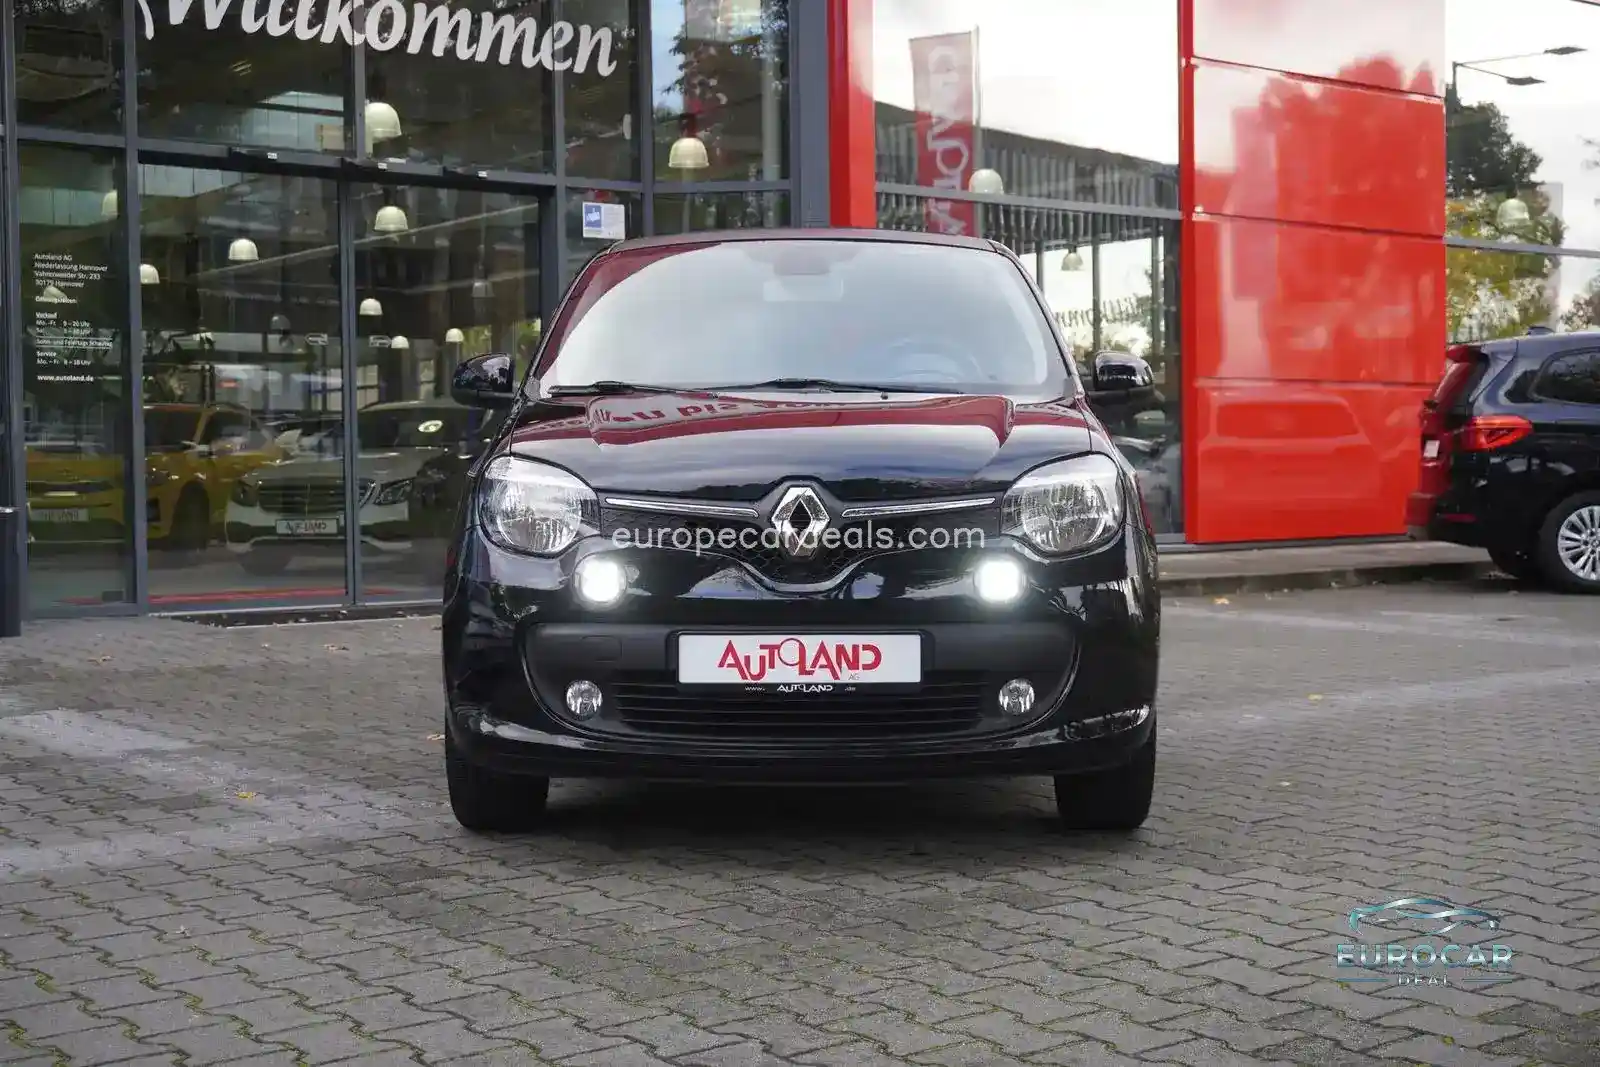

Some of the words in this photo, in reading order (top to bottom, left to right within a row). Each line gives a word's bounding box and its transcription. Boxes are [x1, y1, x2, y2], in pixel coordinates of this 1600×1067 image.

[34, 253, 62, 261] Autoland
[34, 262, 78, 271] Niederlassung
[79, 264, 108, 272] Hannover
[37, 372, 94, 382] www.autoland.de
[716, 637, 883, 681] AUTOLAND
[776, 683, 834, 692] AUTOLAND
